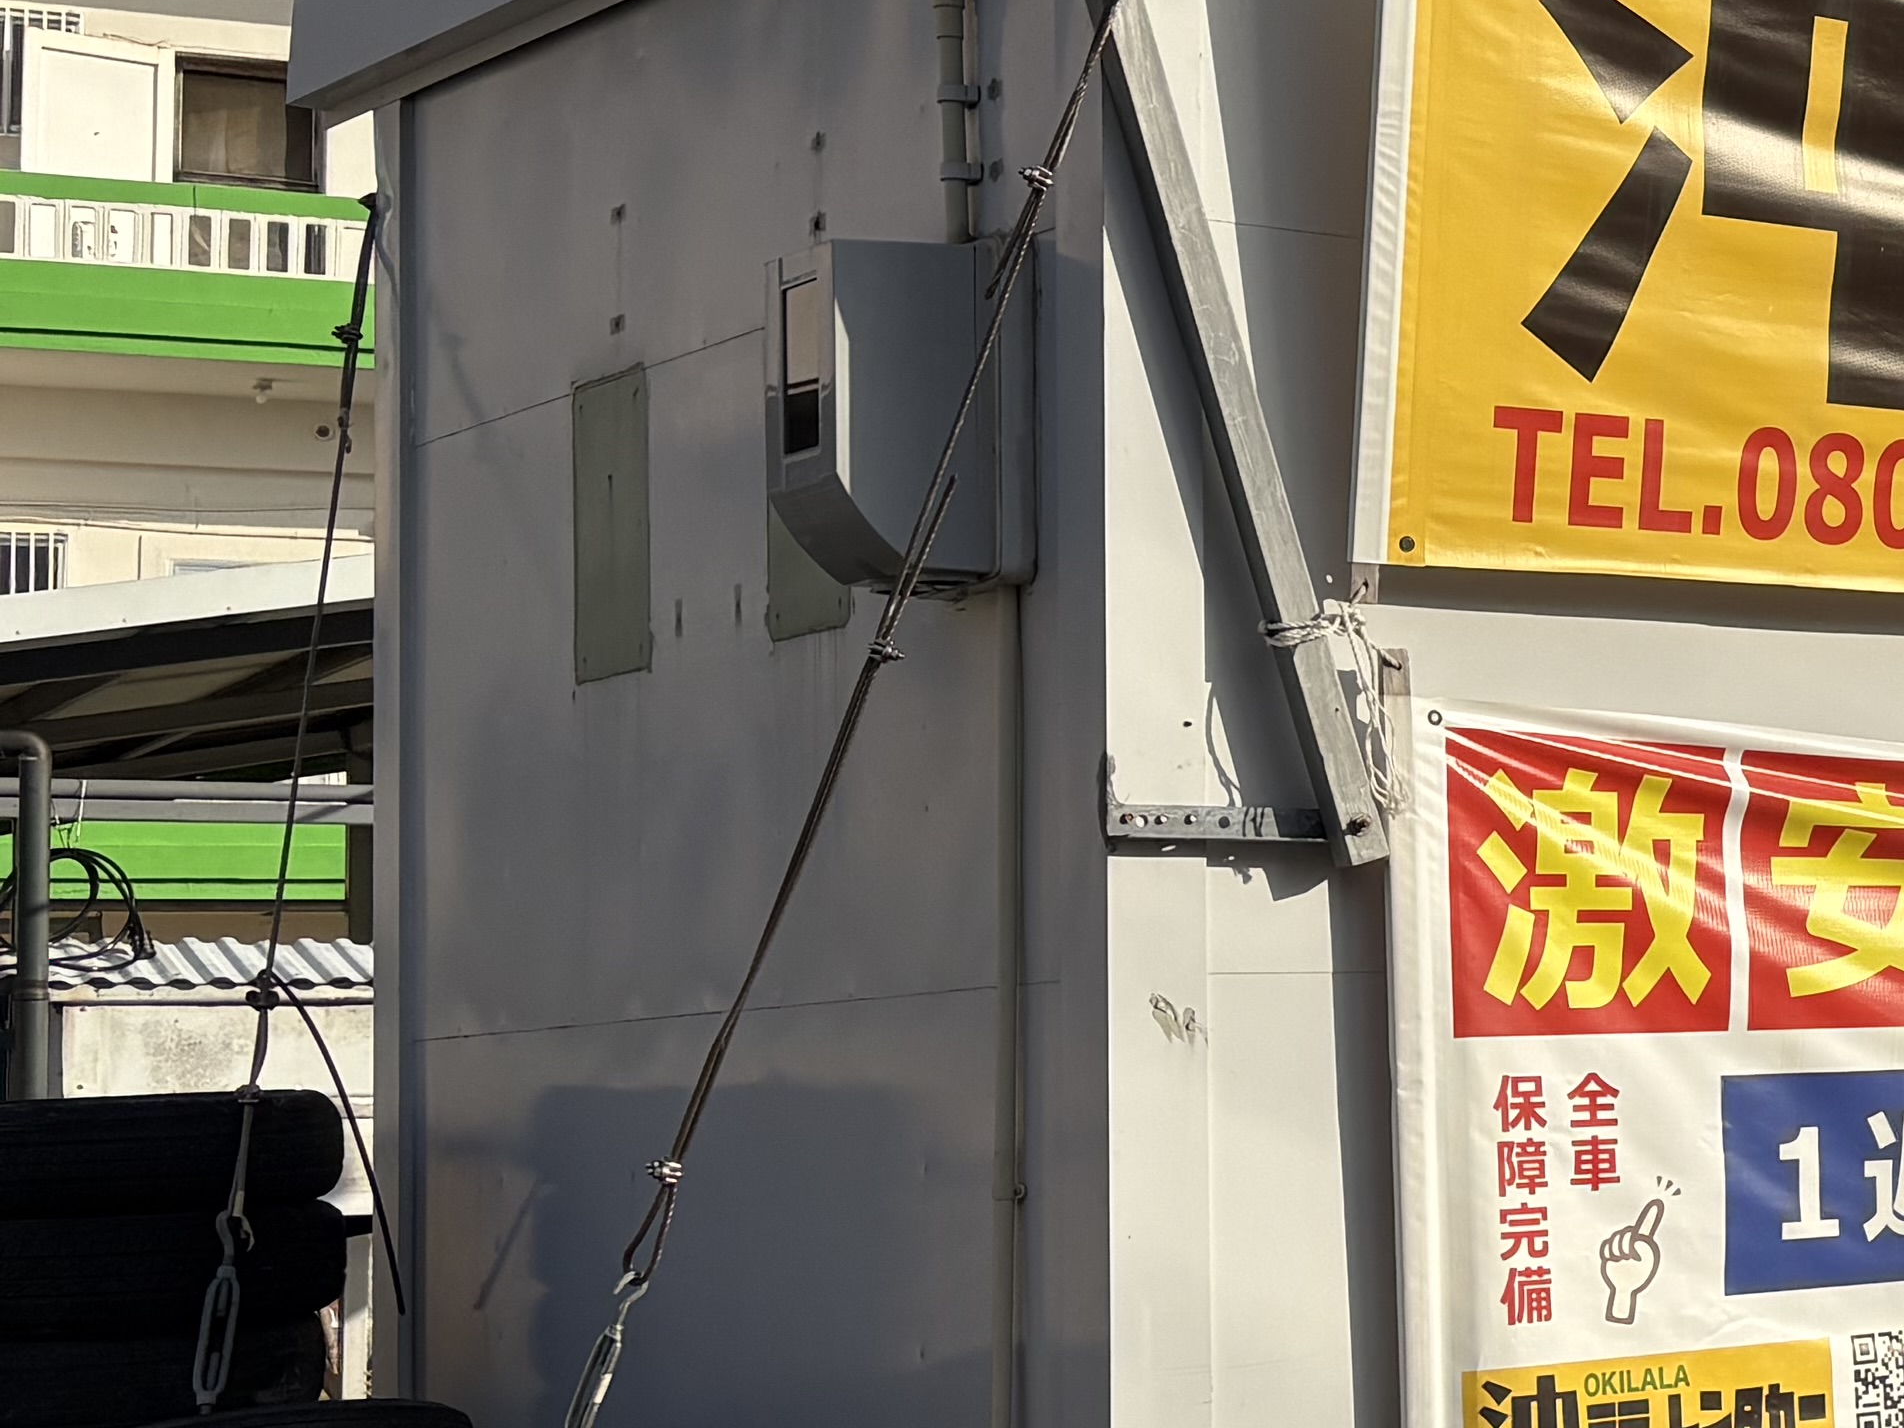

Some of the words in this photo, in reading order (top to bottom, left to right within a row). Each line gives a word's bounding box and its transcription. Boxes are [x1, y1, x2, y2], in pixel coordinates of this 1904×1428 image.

[1567, 1072, 1621, 1191] 全車
[1493, 1075, 1552, 1326] 保障完備
[1583, 1363, 1691, 1398] OKILALA
